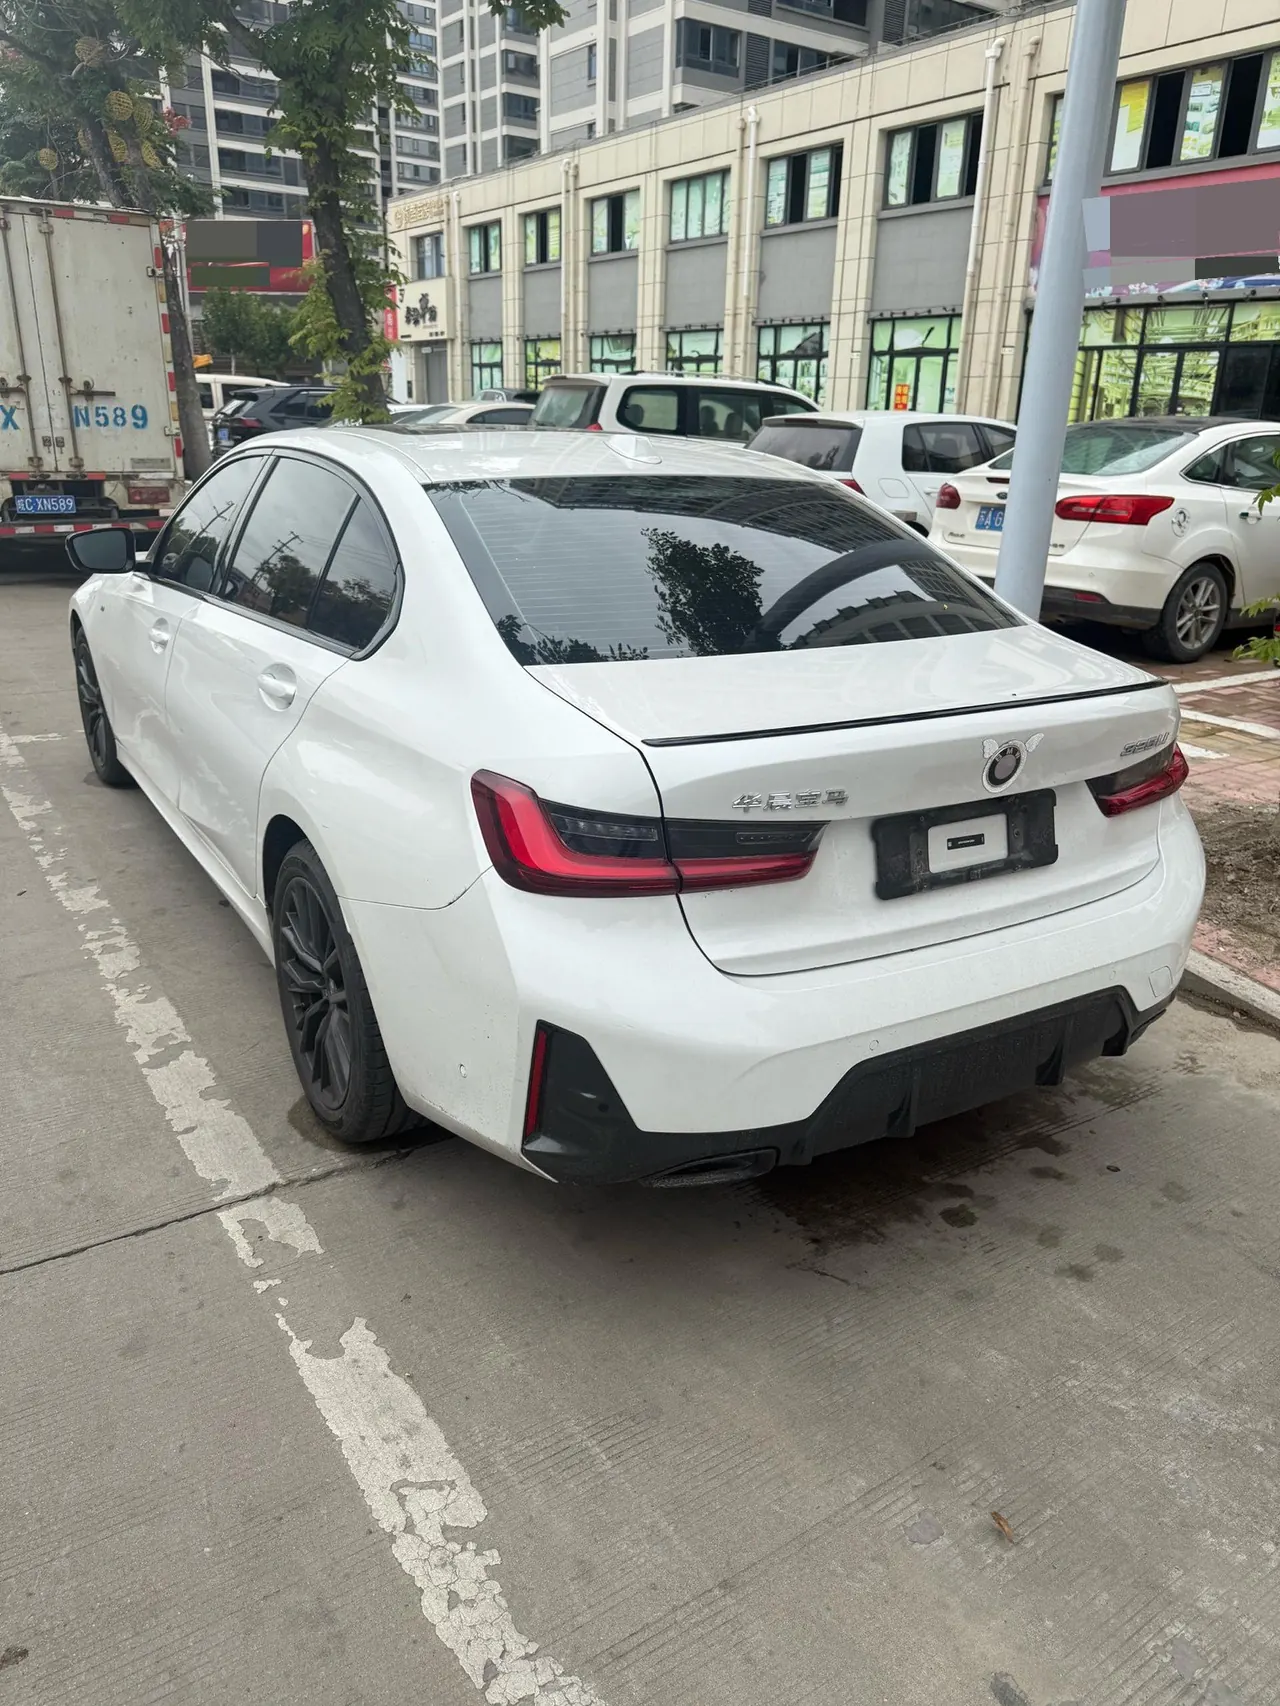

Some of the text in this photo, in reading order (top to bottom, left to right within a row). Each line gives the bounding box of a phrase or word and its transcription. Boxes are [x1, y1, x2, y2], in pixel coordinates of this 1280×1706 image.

[0, 405, 149, 431] X N589
[731, 788, 849, 814] 华晨宝马
